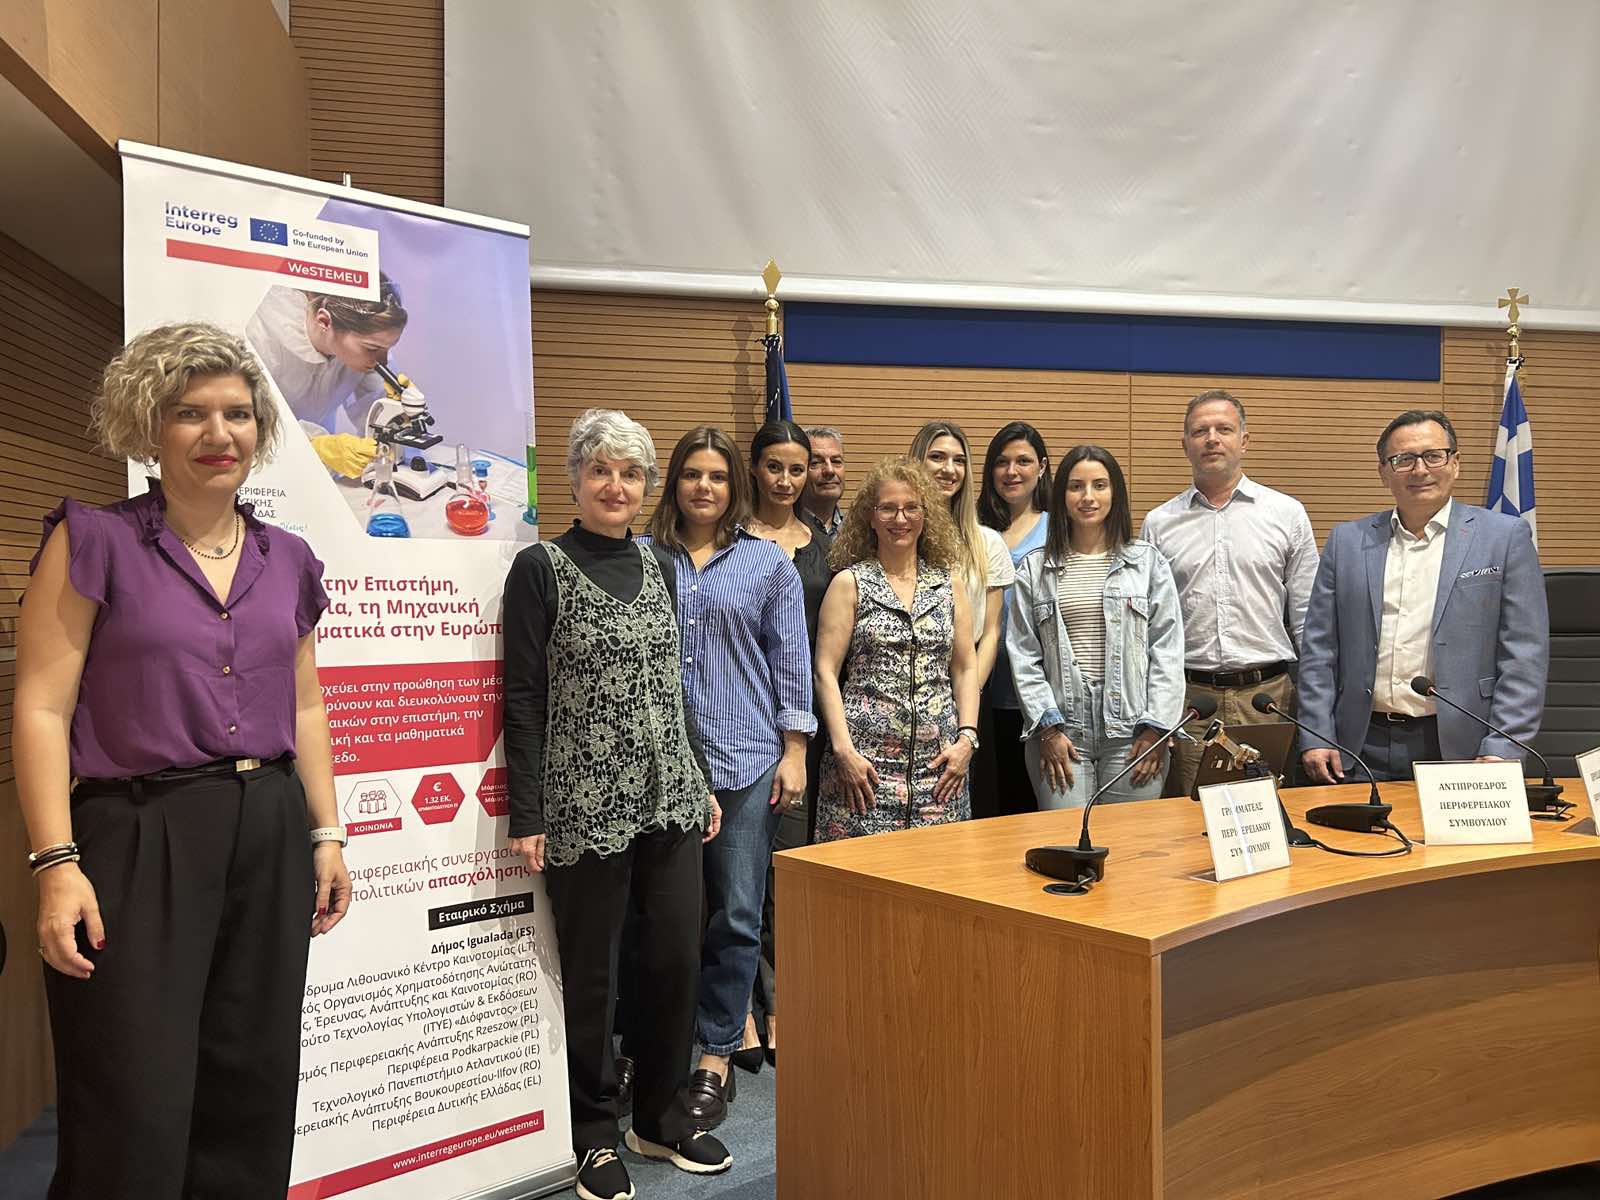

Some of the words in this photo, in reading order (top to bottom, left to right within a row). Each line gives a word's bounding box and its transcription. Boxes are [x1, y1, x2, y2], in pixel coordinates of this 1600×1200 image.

[165, 201, 238, 228] Interreg
[165, 217, 222, 236] Europe
[293, 229, 333, 243] Co-funded
[335, 238, 345, 246] by
[293, 239, 306, 247] the
[308, 241, 344, 254] European
[346, 248, 369, 258] Union
[288, 262, 362, 284] WeSTEMEU
[323, 578, 358, 595] την
[364, 576, 458, 596] Επιστήμη,
[358, 602, 380, 618] τη
[387, 598, 480, 618] Μηχανική
[317, 622, 385, 643] ματικά
[390, 625, 435, 641] στην
[361, 683, 390, 694] στην
[393, 677, 454, 693] προώθηση
[457, 677, 480, 687] των
[326, 698, 373, 714] ρύνουν
[375, 698, 396, 709] και
[398, 692, 480, 707] διευκολύνουν
[329, 714, 367, 729] αικών
[370, 715, 399, 727] στην
[402, 711, 461, 724] επιστήμη,
[464, 709, 484, 720] την
[354, 734, 374, 745] και
[378, 732, 392, 742] τα
[394, 725, 465, 744] μαθηματικά
[332, 751, 360, 765] εδο.
[1439, 781, 1507, 791] ΑΝΤΙΠΡΟΕΔΡΟΣ
[1440, 800, 1511, 810] ΠΕΡΙΦΕΡΕΙΑΚΟΥ
[354, 823, 393, 833] ΚΟΙΝΩΝΙΑ
[1221, 822, 1271, 839] ΠΕΡΙΕΡΕΙΑΚΟΥ
[1449, 818, 1508, 827] ΣΥΜΒΟΥΛΙΟΥ
[1230, 841, 1271, 857] ΣΥΜΟΥΛΙΟΥ
[428, 864, 530, 889] απασχόλησης
[438, 901, 487, 923] Εταιρικό
[489, 898, 525, 916] Σχήμα
[431, 941, 465, 954] Δήμος
[467, 930, 513, 948] Igualada
[516, 925, 536, 940] (ES)
[346, 964, 411, 988] Λιθουανικό
[413, 959, 451, 974] Κέντρο
[453, 945, 516, 966] Καινοτομίας
[517, 941, 536, 955] (LT)
[323, 986, 393, 1011] Οργανισμός
[395, 967, 485, 995] Χρηματοδότησης
[486, 957, 537, 975] Ανώτατης
[314, 1008, 366, 1029] Έρευνας,
[370, 994, 429, 1015] Ανάπτυξης
[431, 991, 448, 1001] και
[451, 976, 514, 997] Καινοτομίας
[515, 970, 537, 984] (RO)
[333, 1016, 404, 1040] Τεχνολογίας
[406, 1000, 475, 1023] Υπολογιστών
[477, 995, 485, 1006] &
[488, 986, 538, 1004] Εκδόσεων
[455, 1005, 517, 1025] «Διόφαντος»
[520, 999, 538, 1012] (EL)
[330, 1043, 415, 1072] Περιφερειακής
[417, 1029, 474, 1051] Ανάπτυξης
[476, 1019, 518, 1037] Rzeszow
[520, 1013, 539, 1028] (PL)
[388, 1053, 449, 1076] Περιφέρεια
[452, 1035, 519, 1059] Podkarpackie
[521, 1028, 540, 1043] (PL)
[312, 1083, 385, 1112] Τεχνολογικό
[388, 1064, 464, 1092] Πανεπιστήμιο
[466, 1048, 522, 1071] Ατλαντικού
[525, 1044, 540, 1059] (IE)
[294, 1112, 349, 1136] ερειακής
[352, 1095, 412, 1120] Ανάπτυξης
[415, 1067, 518, 1102] Βουκουρεστίου-Ilfov
[520, 1059, 541, 1074] (RO)
[372, 1104, 435, 1131] Περιφέρεια
[438, 1092, 478, 1112] Δυτικής
[481, 1080, 522, 1101] Ελλάδας
[523, 1074, 542, 1089] (EL)
[393, 1117, 539, 1169] www.interregeurope.eu/westemeu
